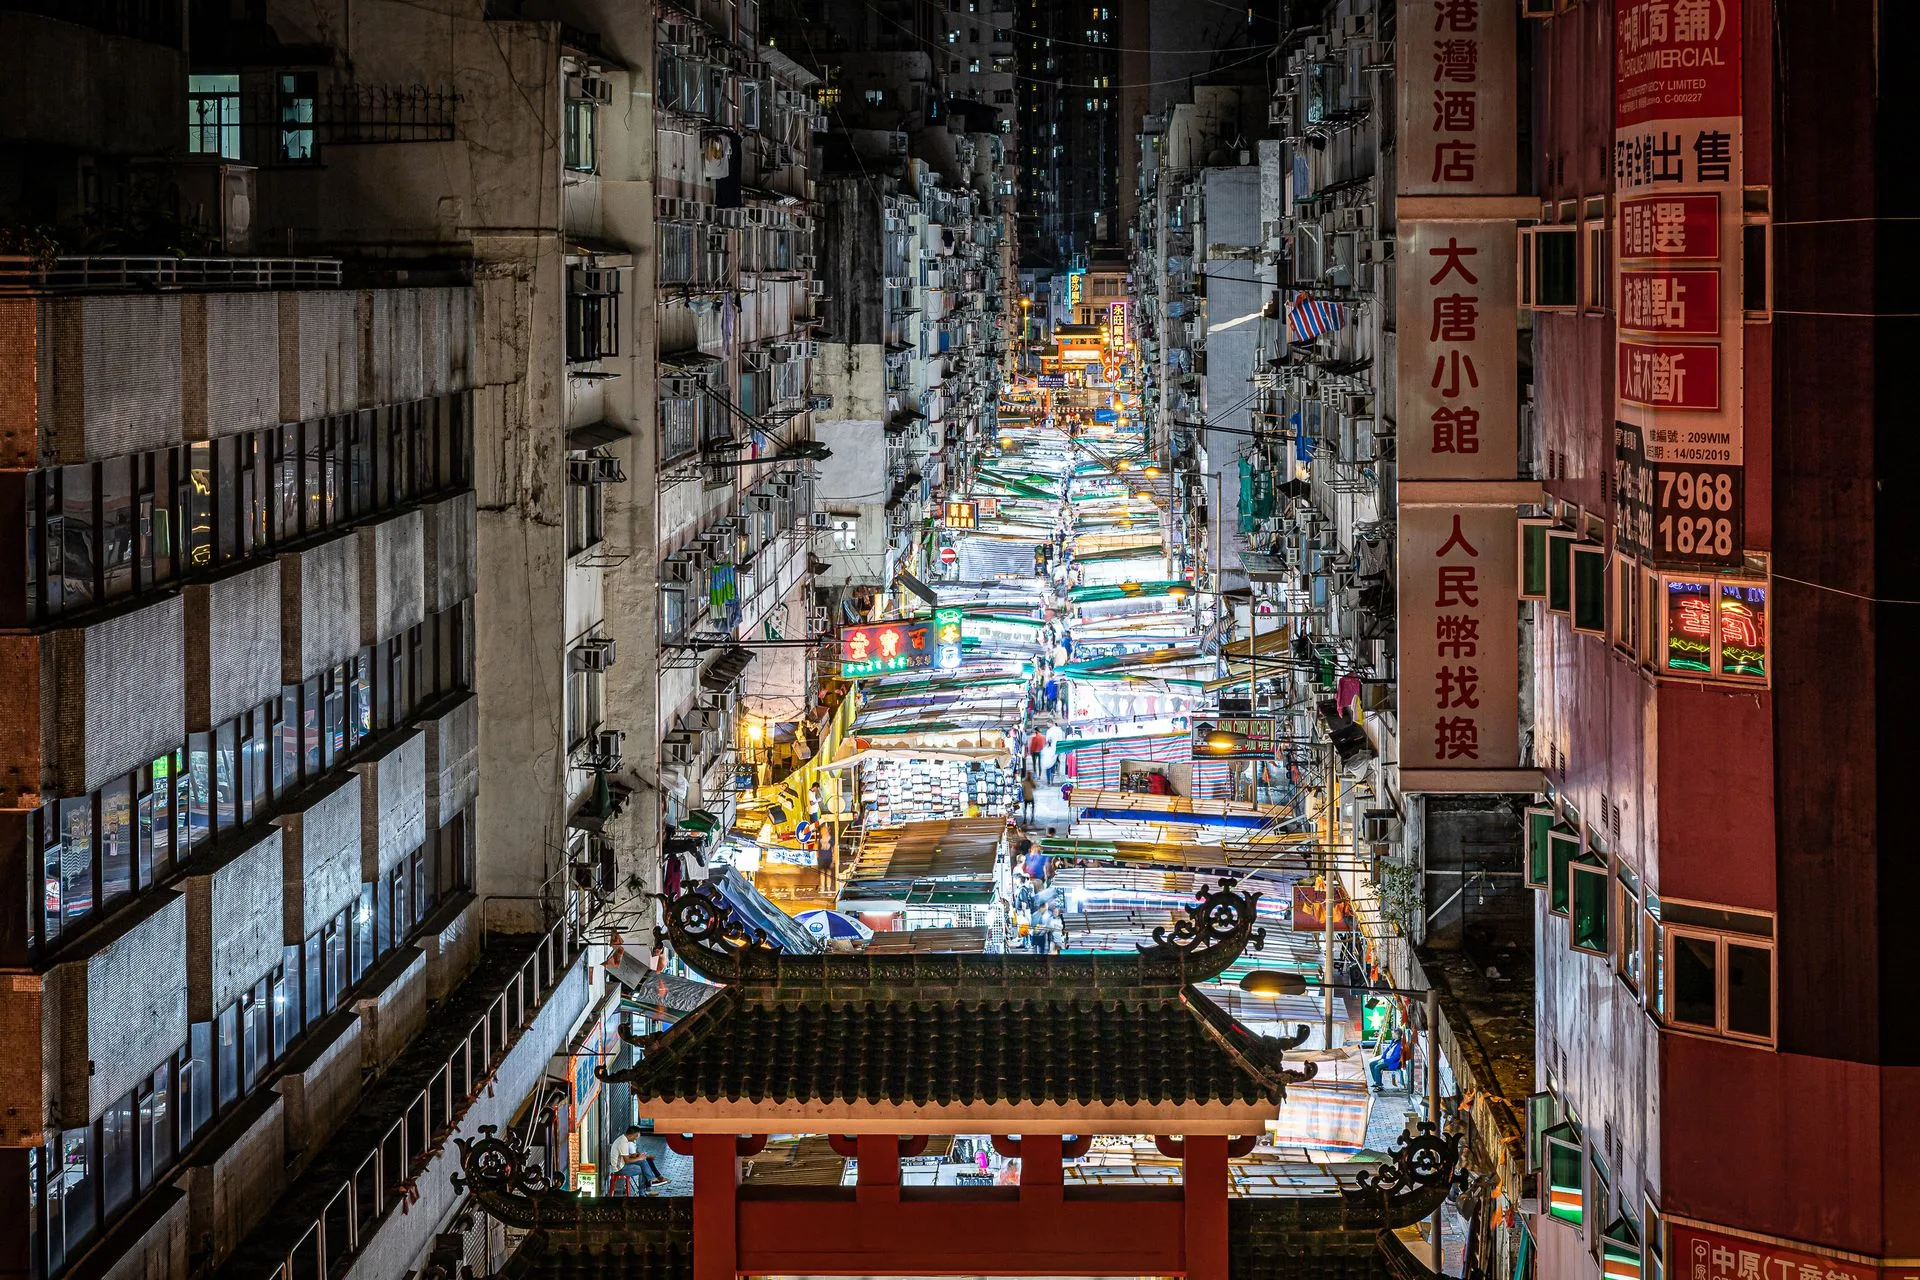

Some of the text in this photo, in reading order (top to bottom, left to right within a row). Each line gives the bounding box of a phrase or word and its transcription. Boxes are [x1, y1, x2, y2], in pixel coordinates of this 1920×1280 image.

[1431, 0, 1479, 183] 港灣酒店
[1664, 93, 1703, 104] C-000227
[1667, 79, 1707, 91] LIMITED
[1623, 202, 1687, 255] 同區首選
[1429, 237, 1480, 454] 大唐小館
[1624, 348, 1687, 403] 人流不斷
[1673, 448, 1731, 461] 14/05/2019
[1687, 431, 1731, 445] 209WIM
[1657, 470, 1733, 512] 7968
[1658, 514, 1733, 556] 1828
[1434, 514, 1480, 760] 人民幣找換
[1233, 720, 1248, 735] CURRY
[1249, 721, 1270, 736] KITCHEN
